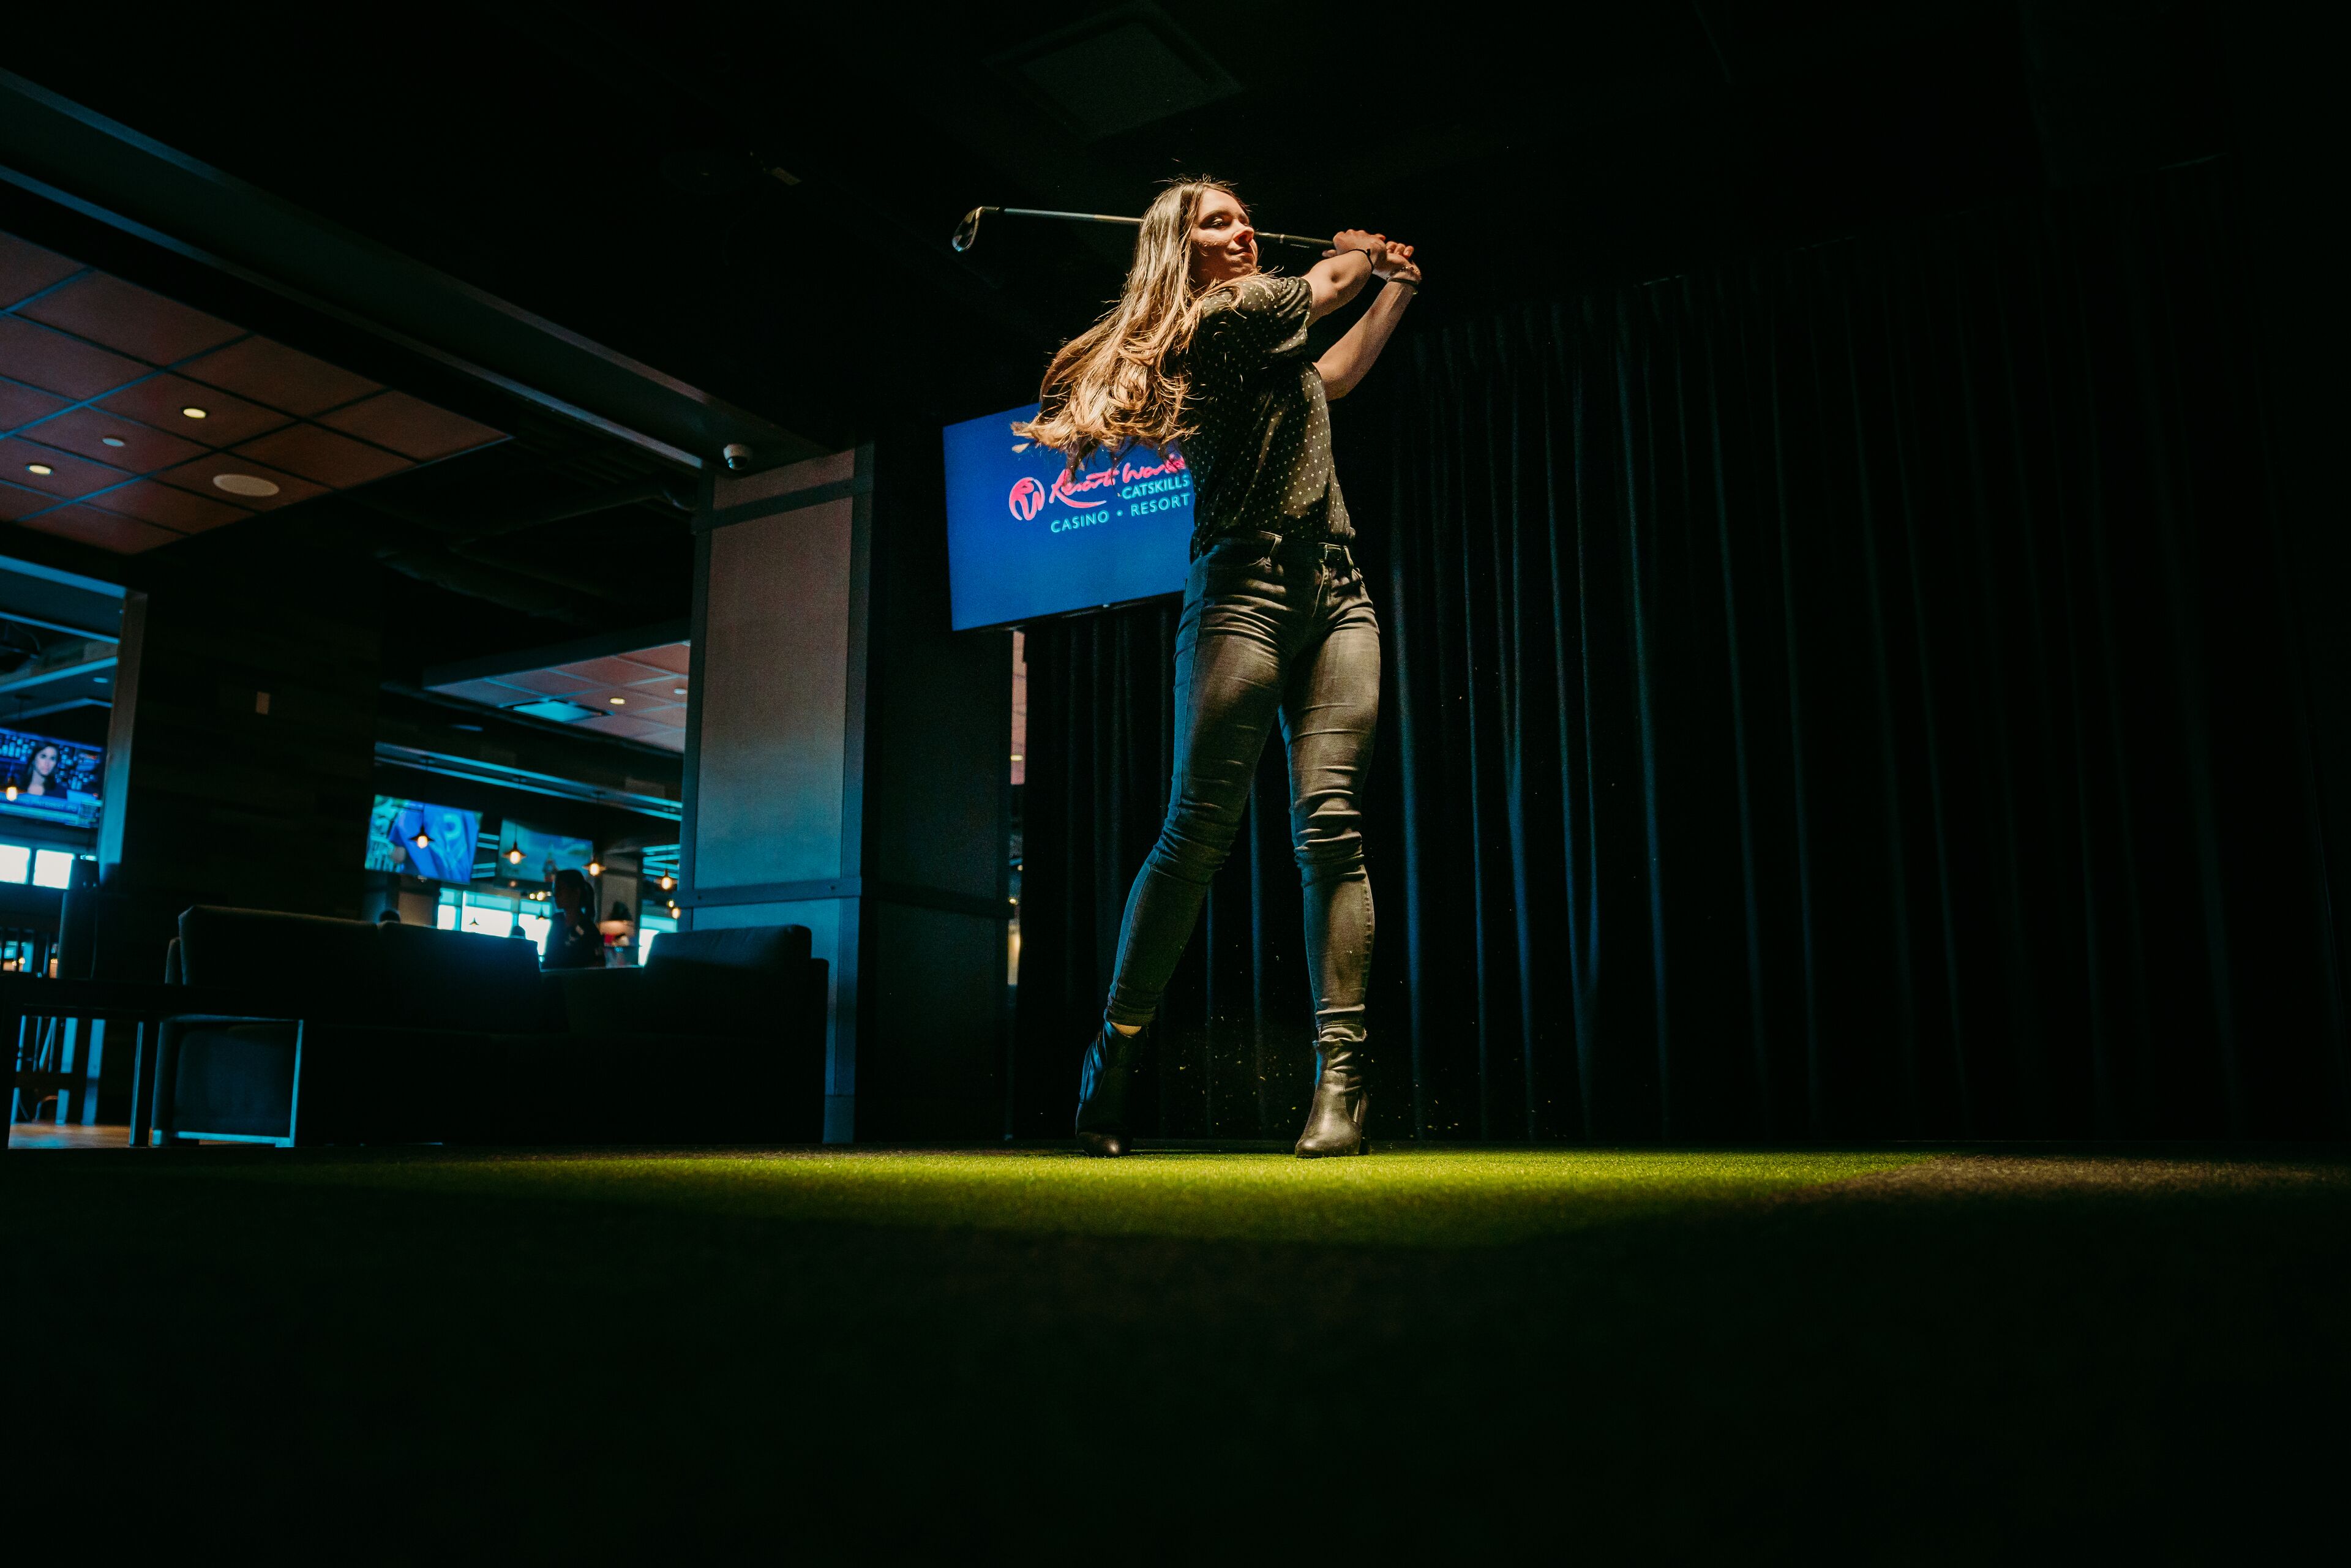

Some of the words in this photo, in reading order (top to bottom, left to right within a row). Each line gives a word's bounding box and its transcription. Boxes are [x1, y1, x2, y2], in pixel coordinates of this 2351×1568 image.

[1122, 474, 1191, 500] CATSKILLS
[1051, 510, 1109, 533] CASINO
[1131, 492, 1190, 517] RESORT
